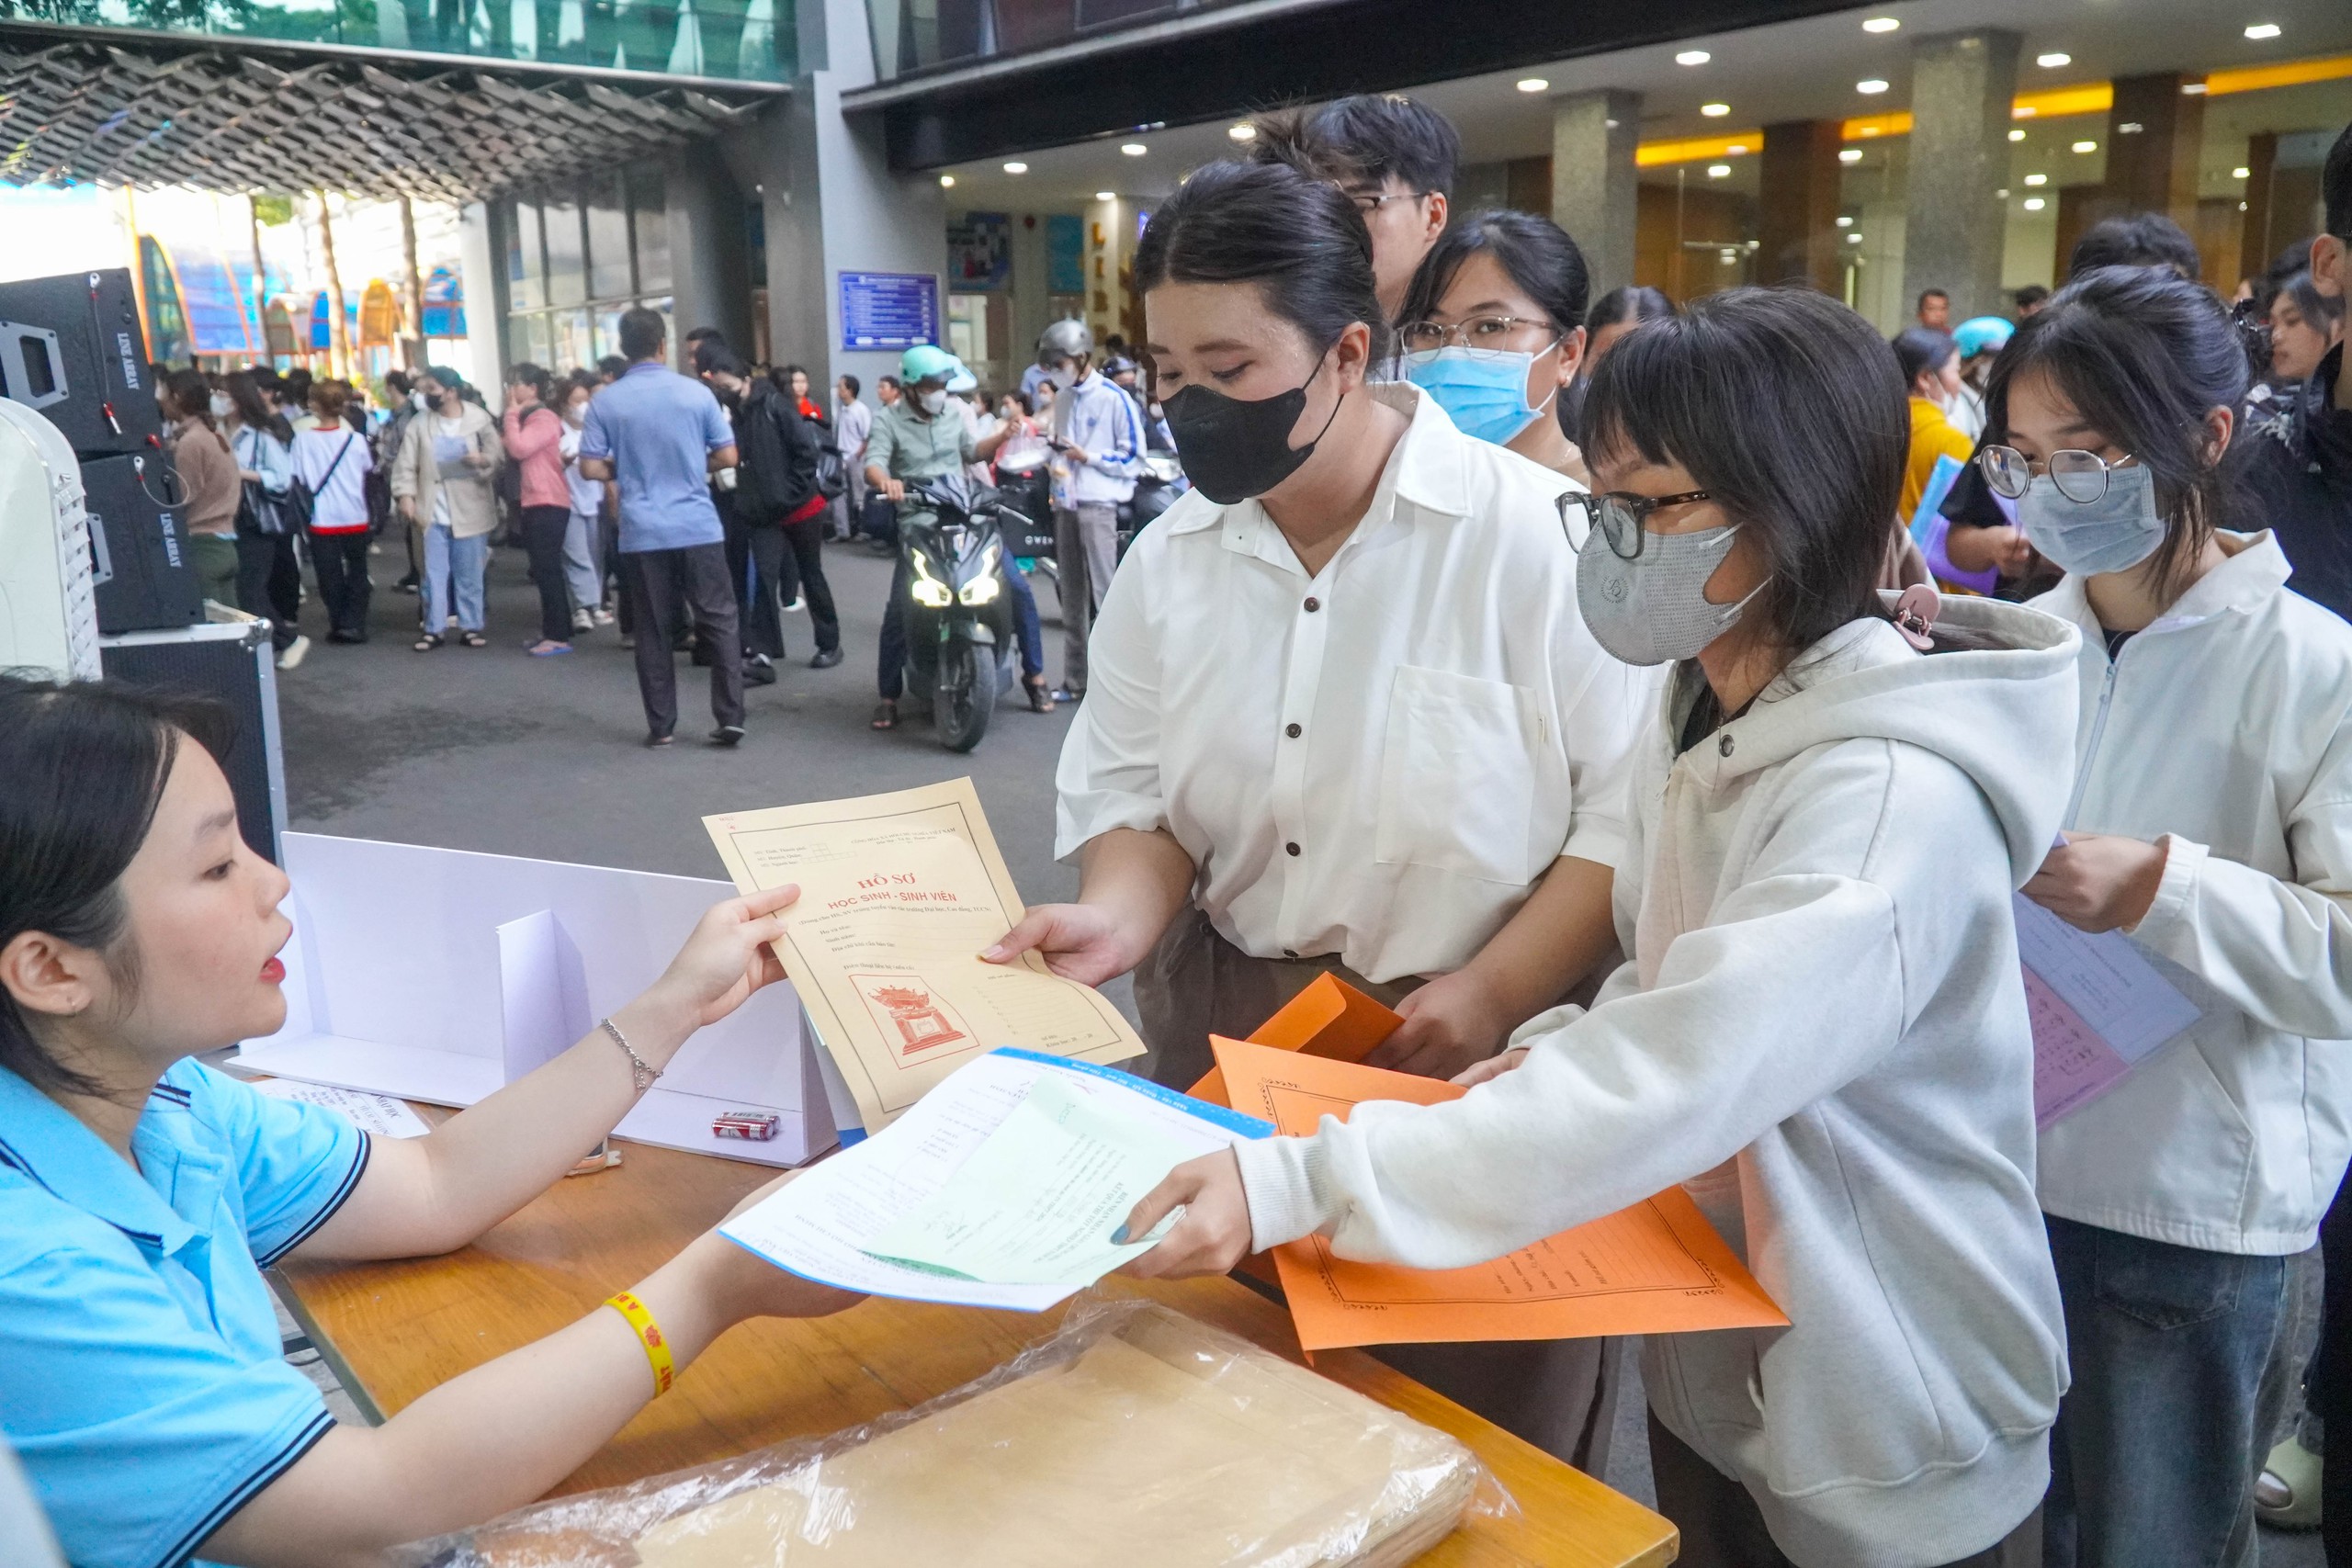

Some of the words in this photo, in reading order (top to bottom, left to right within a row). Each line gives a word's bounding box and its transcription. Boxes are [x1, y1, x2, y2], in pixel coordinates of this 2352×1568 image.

[117, 332, 133, 356] LINE
[122, 356, 140, 390] ARRAY
[160, 513, 175, 536] LINE
[165, 536, 182, 567] ARRAY
[857, 873, 888, 889] HỒ
[892, 872, 916, 884] SƠ
[828, 897, 858, 909] HỌC
[861, 891, 891, 902] SINH
[900, 891, 928, 901] SINH
[930, 890, 957, 901] VIÊN
